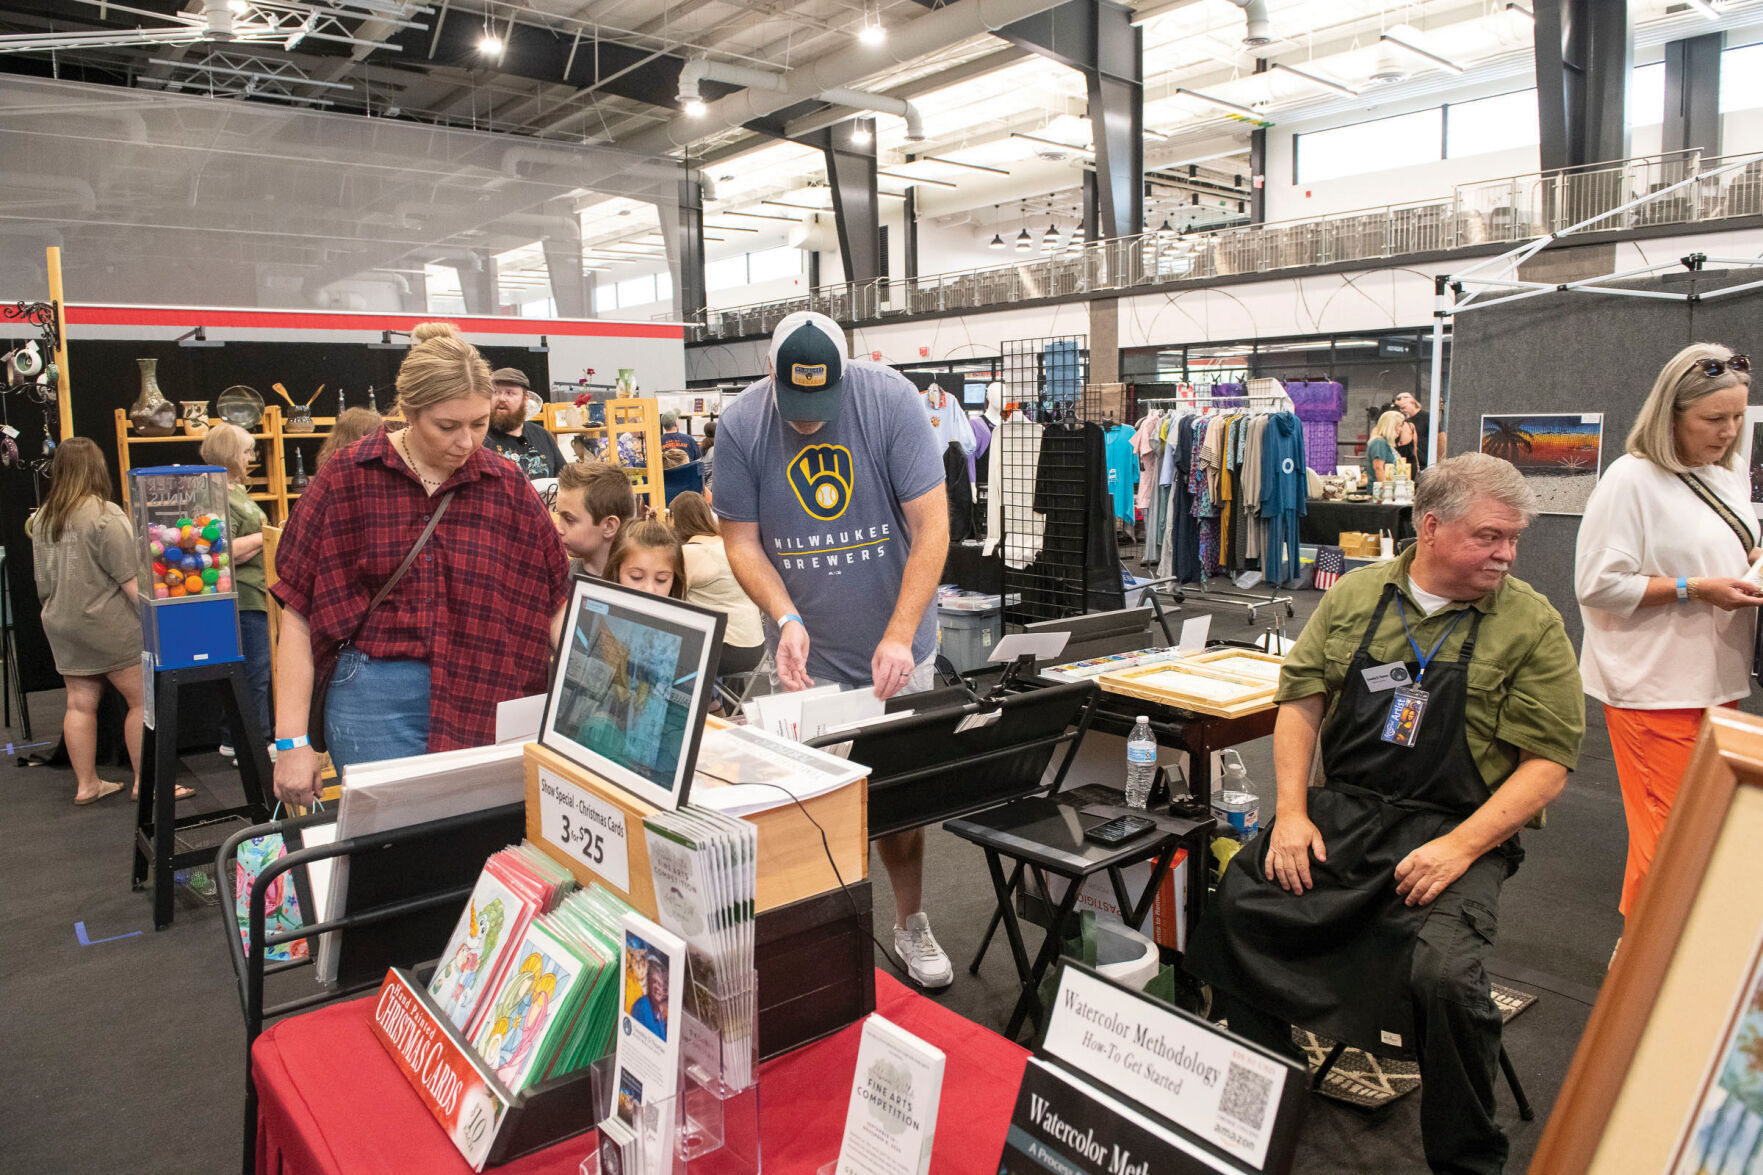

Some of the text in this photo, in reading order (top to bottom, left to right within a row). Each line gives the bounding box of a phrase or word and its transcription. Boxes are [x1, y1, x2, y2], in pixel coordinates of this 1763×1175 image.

[774, 523, 890, 549] MILWAUKEE
[783, 545, 885, 569] BREWERS
[1391, 698, 1406, 721] Artist
[541, 778, 555, 797] Show
[556, 786, 575, 809] Special
[579, 800, 607, 828] Christmas
[607, 816, 624, 838] Cards
[561, 815, 604, 864] 3 for $25
[394, 984, 436, 1040] Hand Painted
[376, 983, 463, 1115] CHRISTMAS CARDS
[1064, 989, 1130, 1038] Watercolor
[1133, 1023, 1221, 1088] Methodology
[1082, 1031, 1183, 1096] How-To Get Started
[857, 1086, 920, 1131] COMPETITION
[867, 1078, 912, 1112] FINE ARTS
[1029, 1142, 1036, 1155] A
[1030, 1092, 1108, 1166] Watercolor
[1214, 1123, 1255, 1151] amazon
